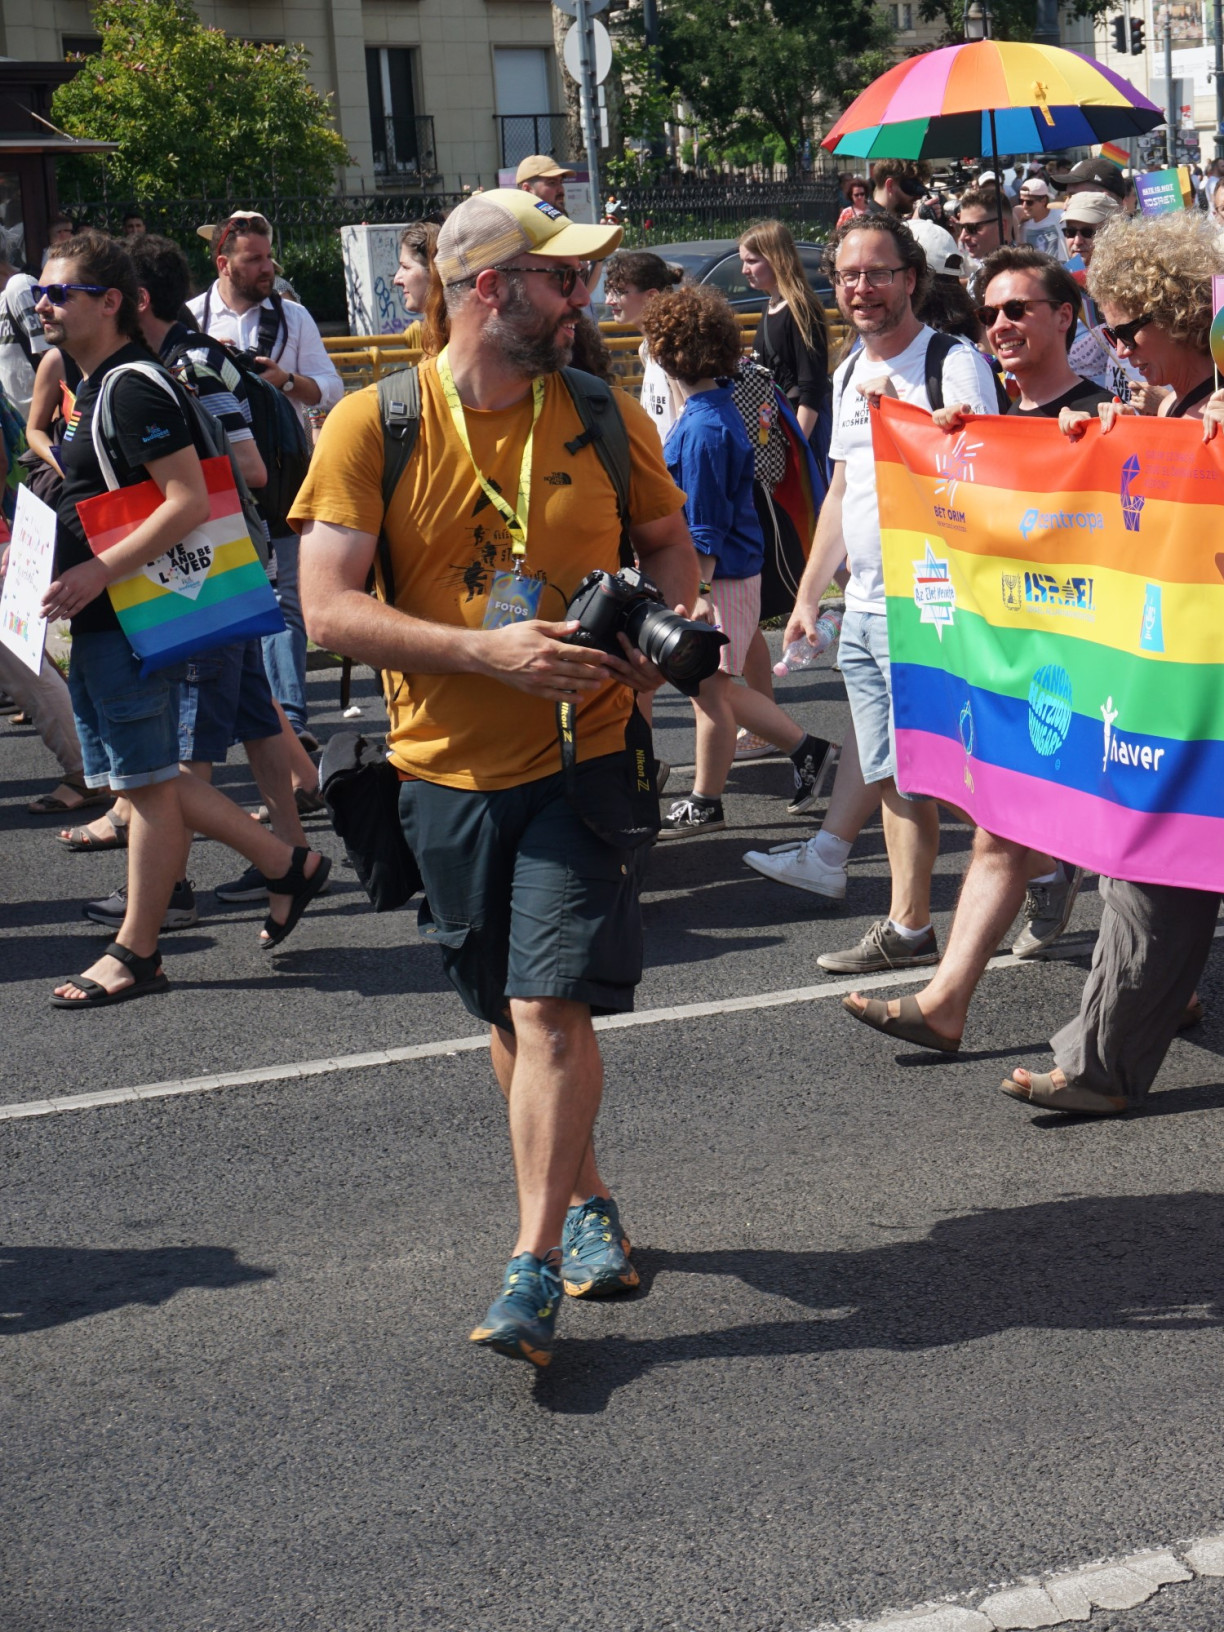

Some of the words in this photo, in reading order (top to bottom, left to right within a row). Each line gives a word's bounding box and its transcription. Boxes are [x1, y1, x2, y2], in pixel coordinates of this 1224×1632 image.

[855, 410, 869, 418] NOT
[947, 509, 966, 523] ORIM
[171, 552, 196, 568] AND
[197, 545, 212, 558] BE
[495, 601, 529, 616] FOTÓS
[1110, 733, 1165, 772] haver
